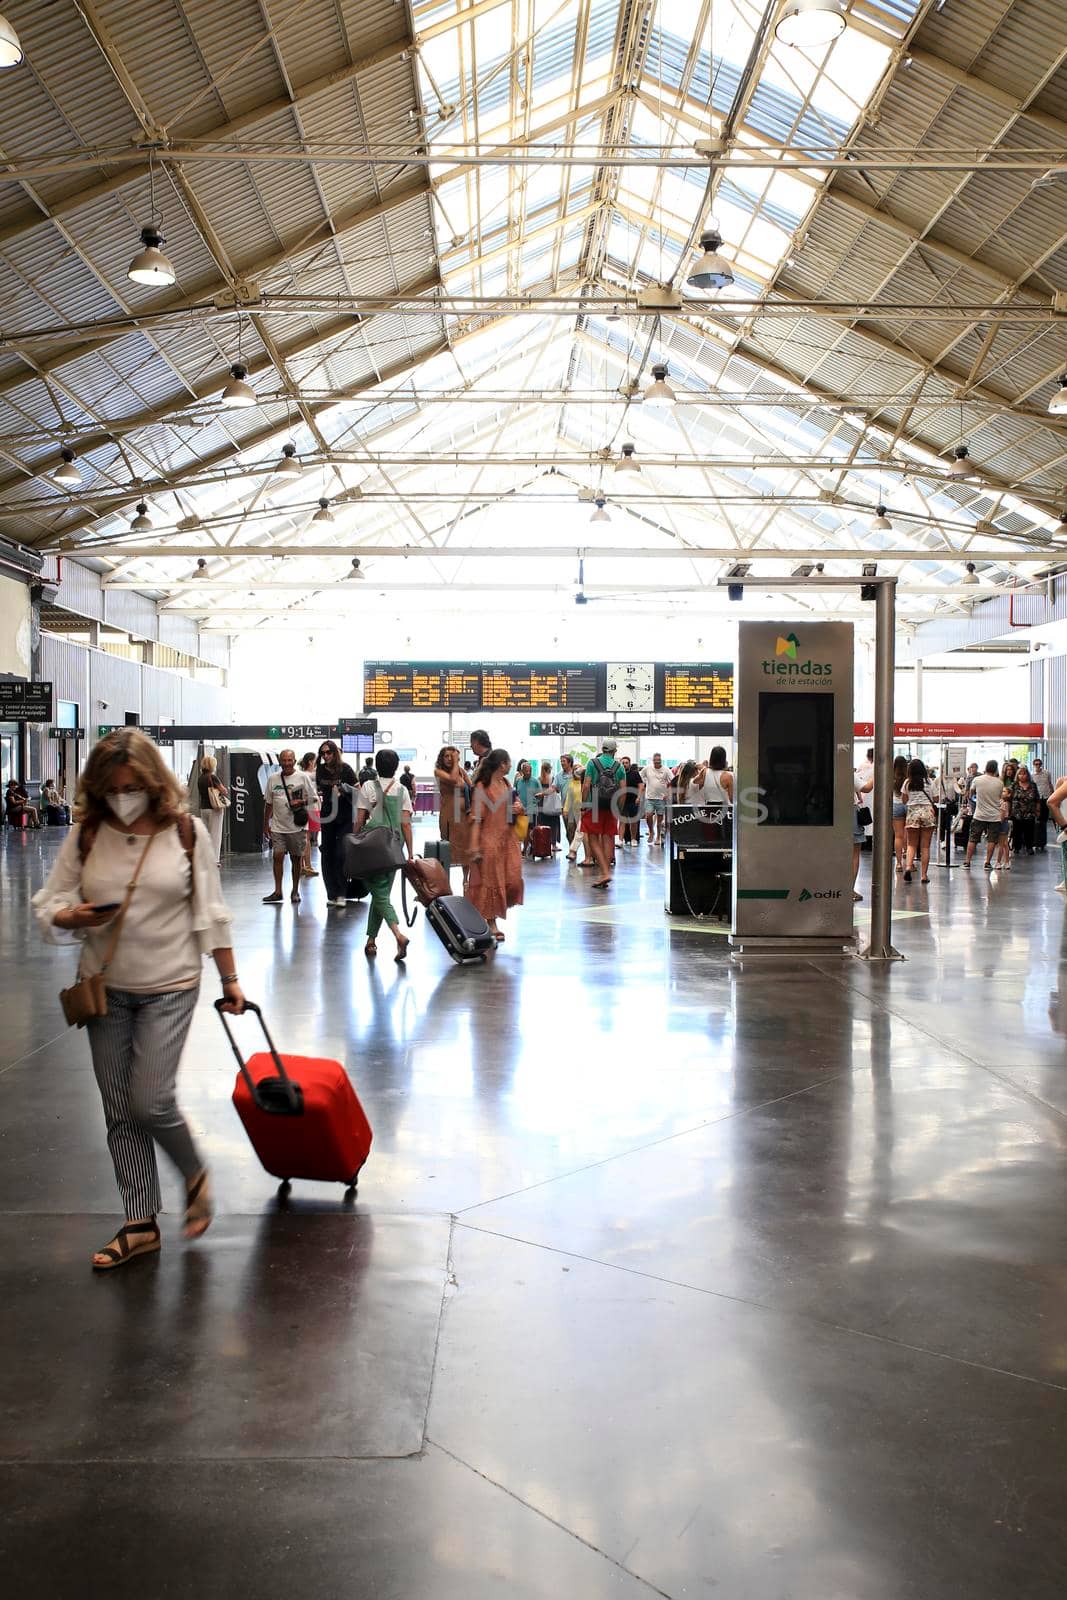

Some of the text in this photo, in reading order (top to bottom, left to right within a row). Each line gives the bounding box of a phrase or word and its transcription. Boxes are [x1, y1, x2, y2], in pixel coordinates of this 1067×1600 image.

[761, 660, 832, 675] tiendas
[776, 677, 833, 687] de la estación
[287, 726, 314, 738] 9:14
[548, 723, 566, 735] 1:6
[232, 775, 250, 823] renfe
[813, 888, 842, 899] adif
